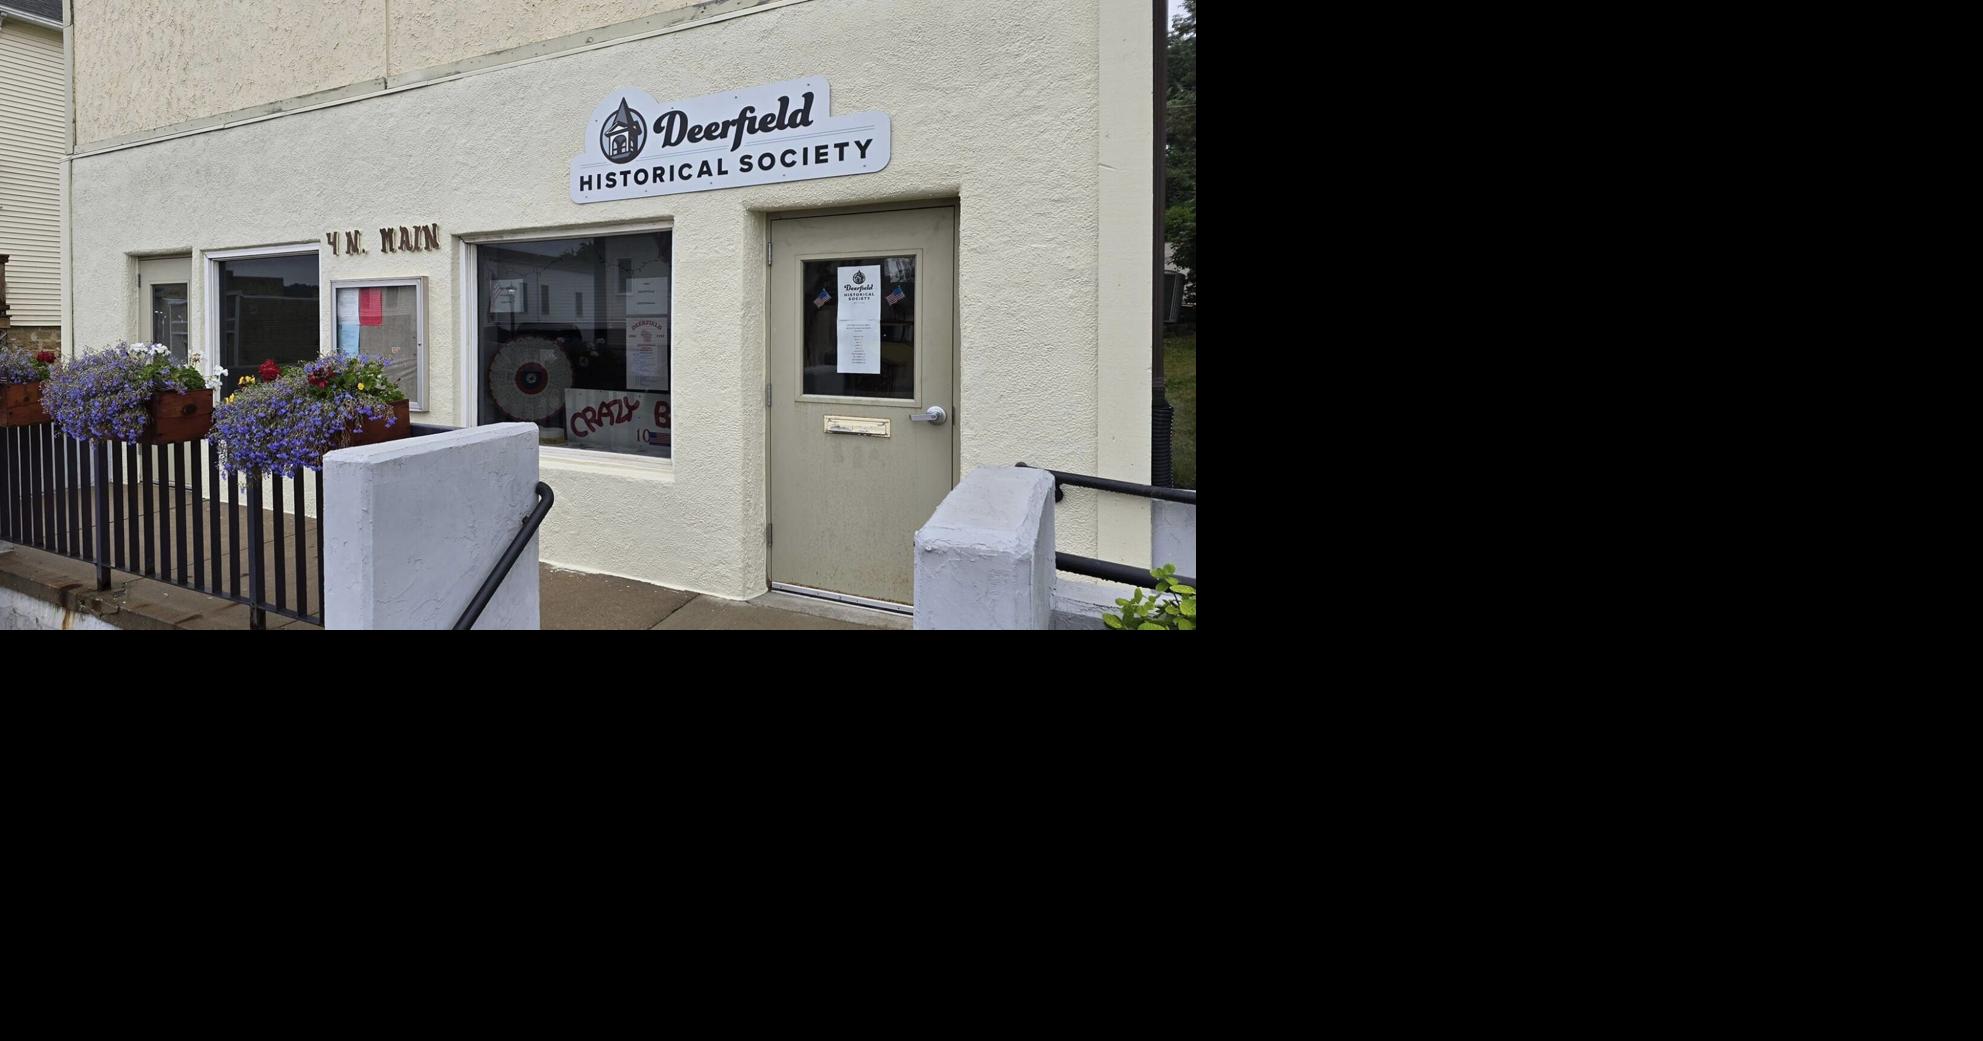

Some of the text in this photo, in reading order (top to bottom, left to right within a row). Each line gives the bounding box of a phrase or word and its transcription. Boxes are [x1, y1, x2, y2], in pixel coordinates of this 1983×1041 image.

[652, 91, 815, 152] Deerfield
[579, 138, 873, 192] HISTORICAL SOCIETY
[326, 231, 338, 255] 4
[379, 223, 441, 254] MAIN
[843, 284, 874, 293] Deerfield
[570, 396, 641, 438] CRAZY
